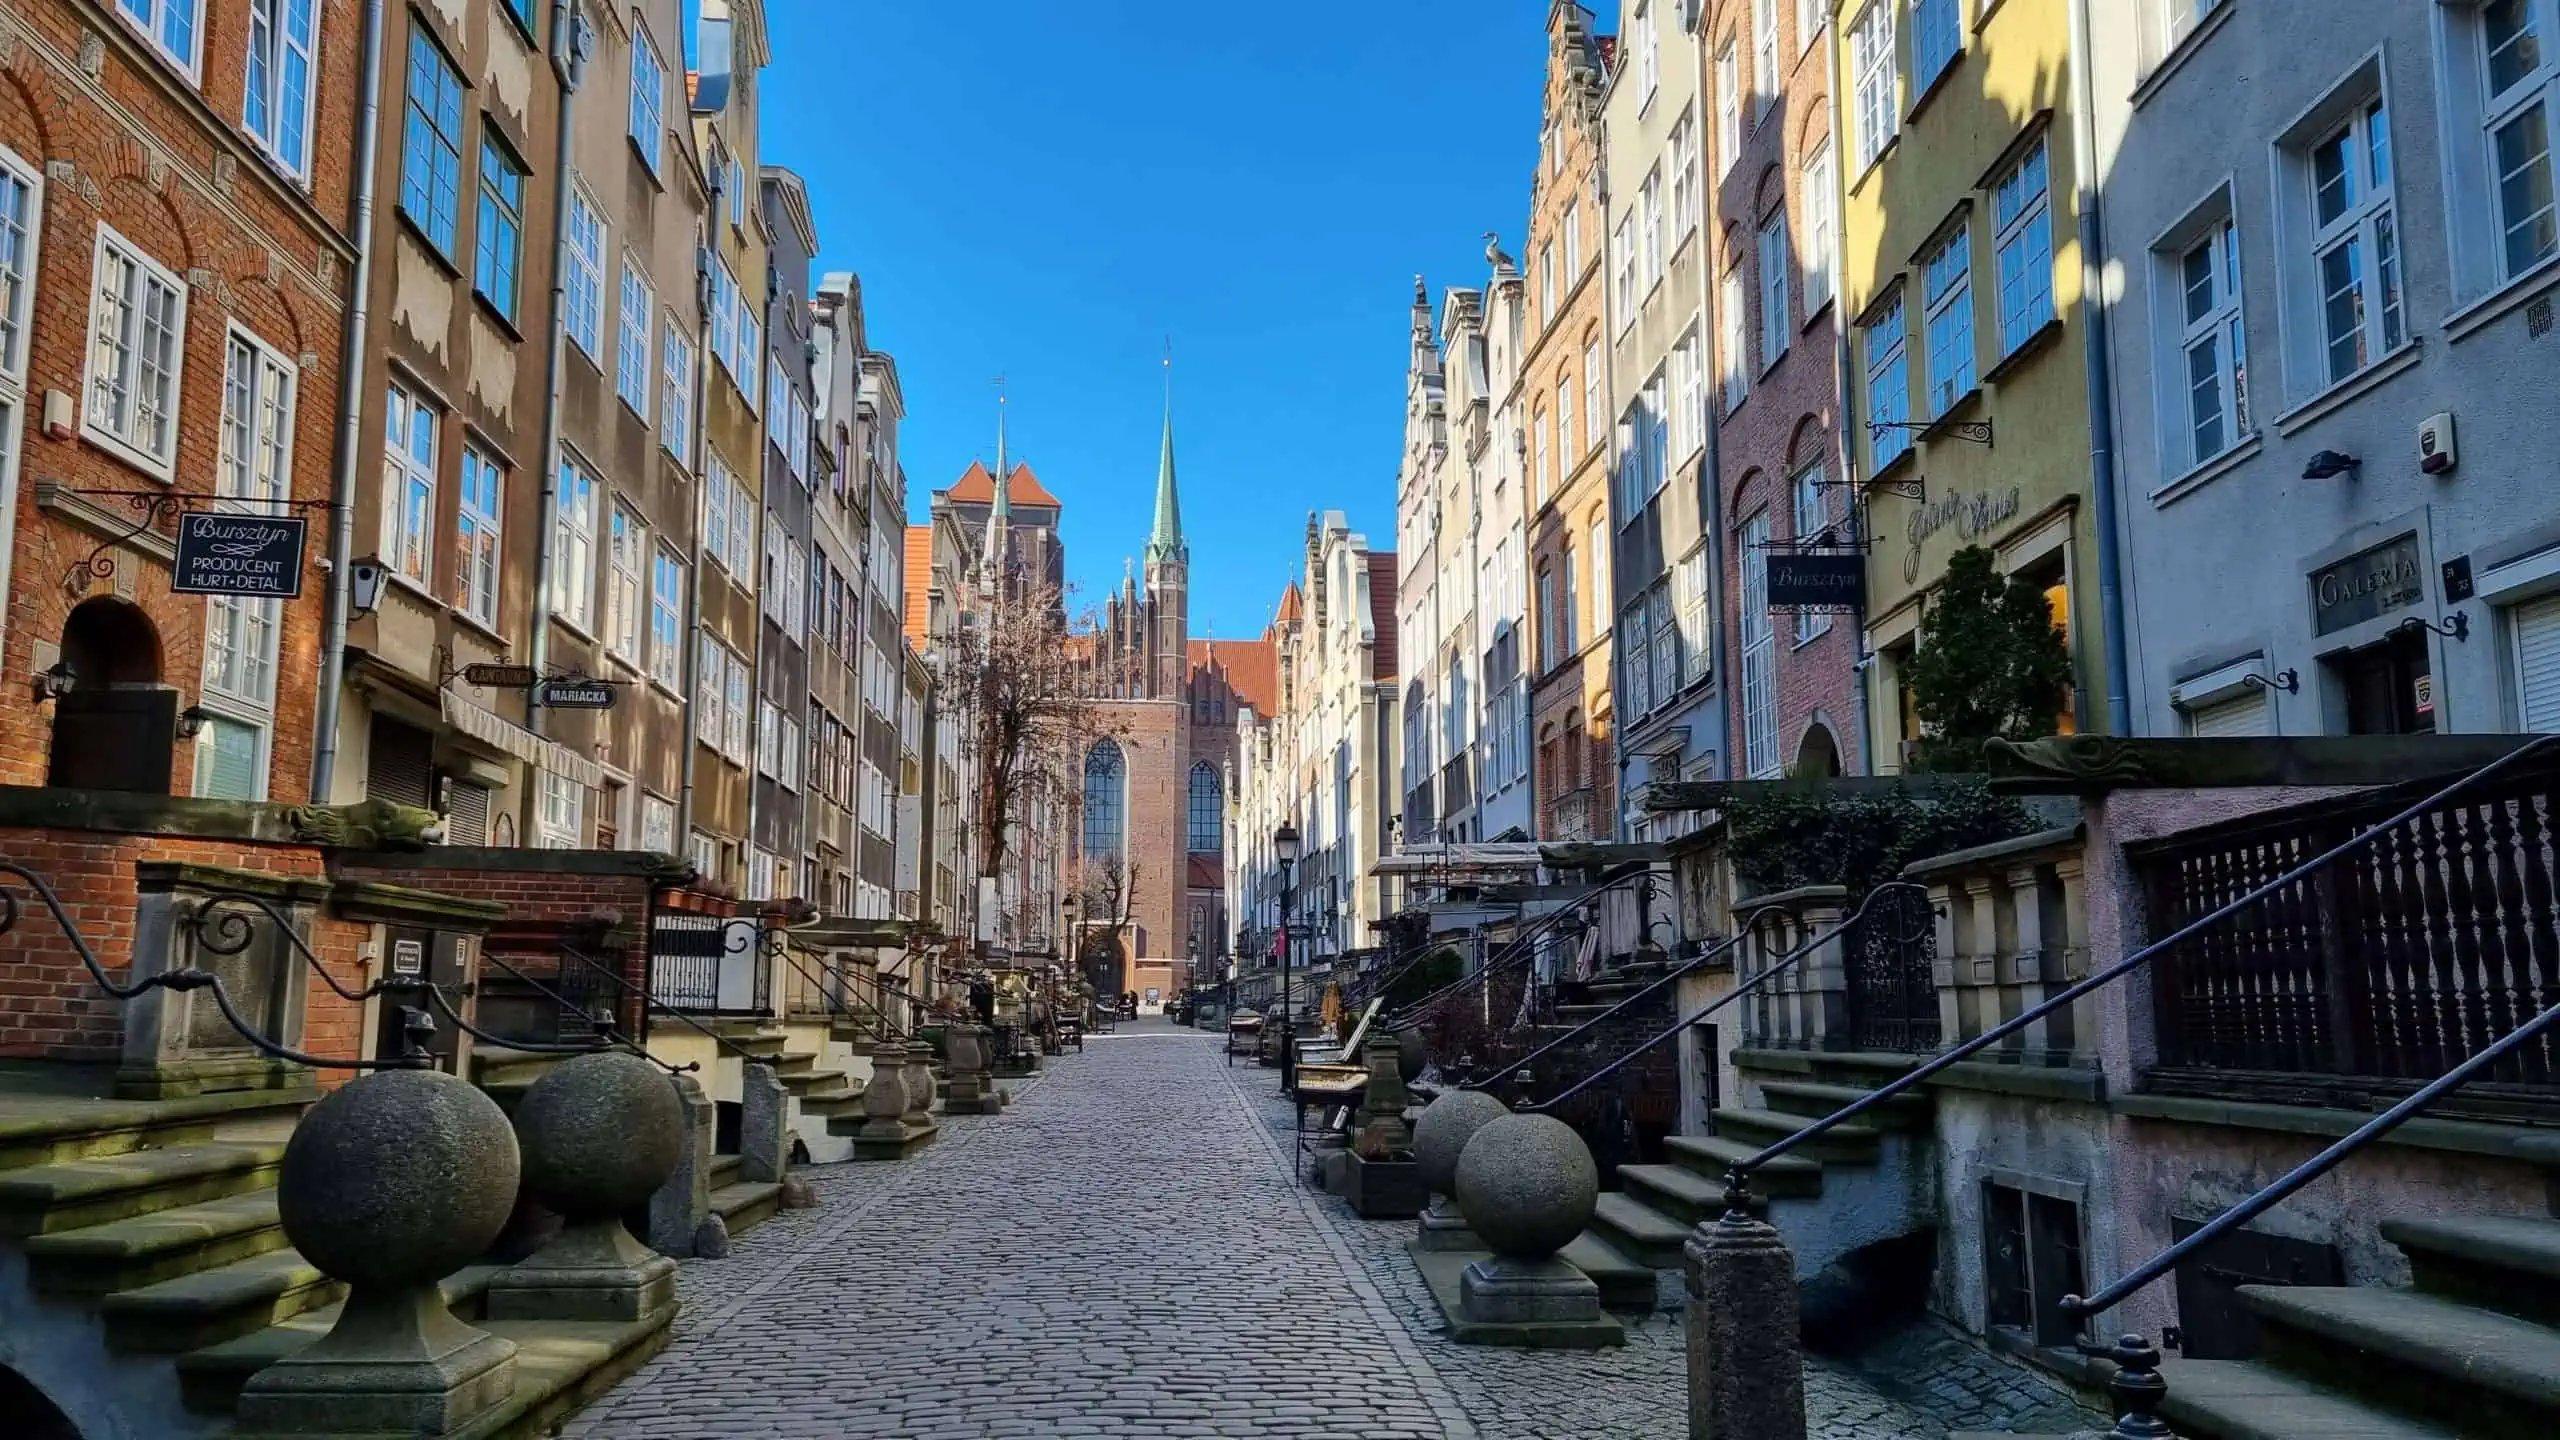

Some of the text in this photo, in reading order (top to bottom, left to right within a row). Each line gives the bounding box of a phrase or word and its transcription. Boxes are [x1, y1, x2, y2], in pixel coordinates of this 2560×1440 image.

[193, 517, 289, 545] Bursztyn
[192, 557, 282, 574] PRODUCENT
[1774, 565, 1856, 592] Bursztyn
[2319, 559, 2416, 607] GALERIA
[550, 689, 607, 703] MARIACKA
